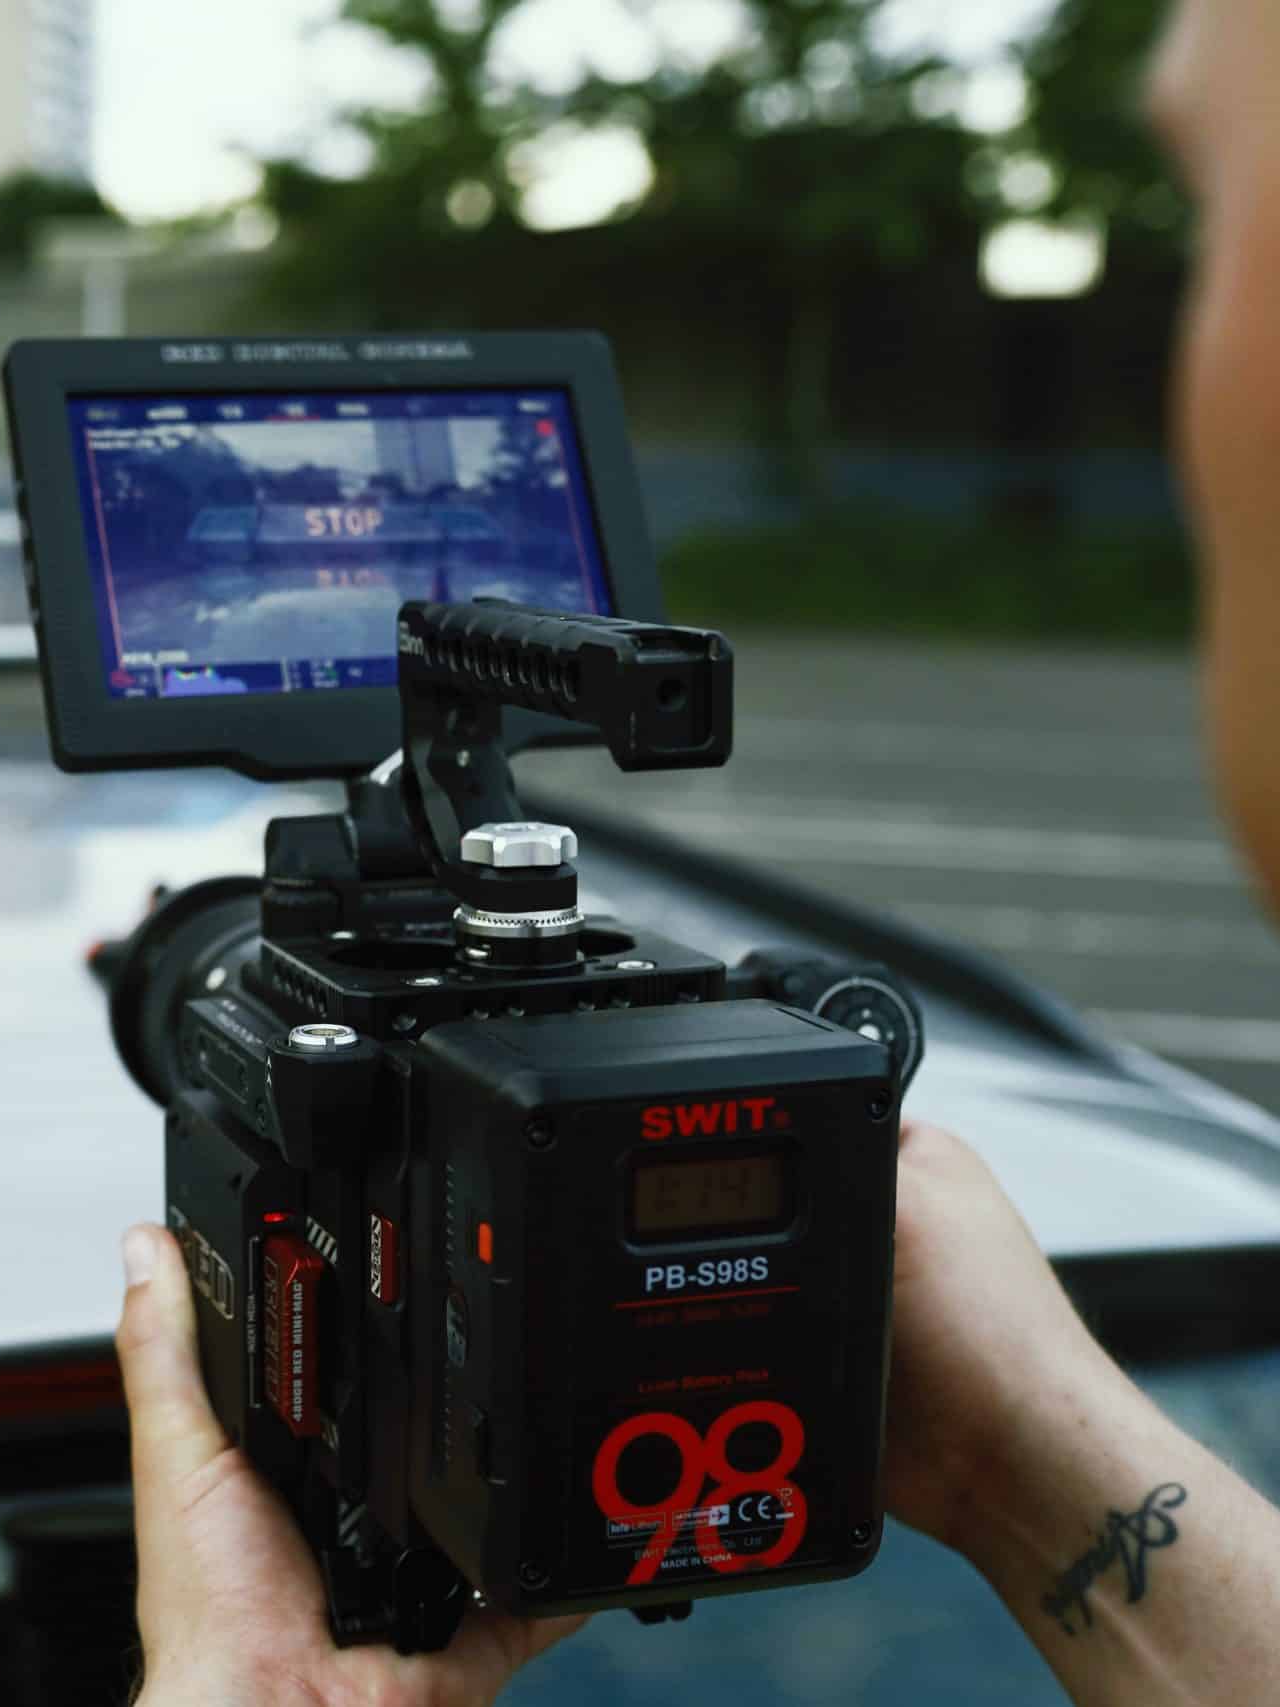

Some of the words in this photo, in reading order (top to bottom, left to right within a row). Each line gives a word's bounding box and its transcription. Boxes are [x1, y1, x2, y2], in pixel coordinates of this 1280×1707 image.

[304, 507, 384, 537] STOP
[641, 1097, 776, 1141] SWIT
[645, 1257, 769, 1292] PB-S98S
[292, 1349, 303, 1374] RED
[592, 1400, 807, 1585] 98
[738, 1495, 772, 1522] CE
[660, 1558, 689, 1569] MADE
[691, 1557, 701, 1566] IN
[702, 1553, 733, 1565] CHINA
